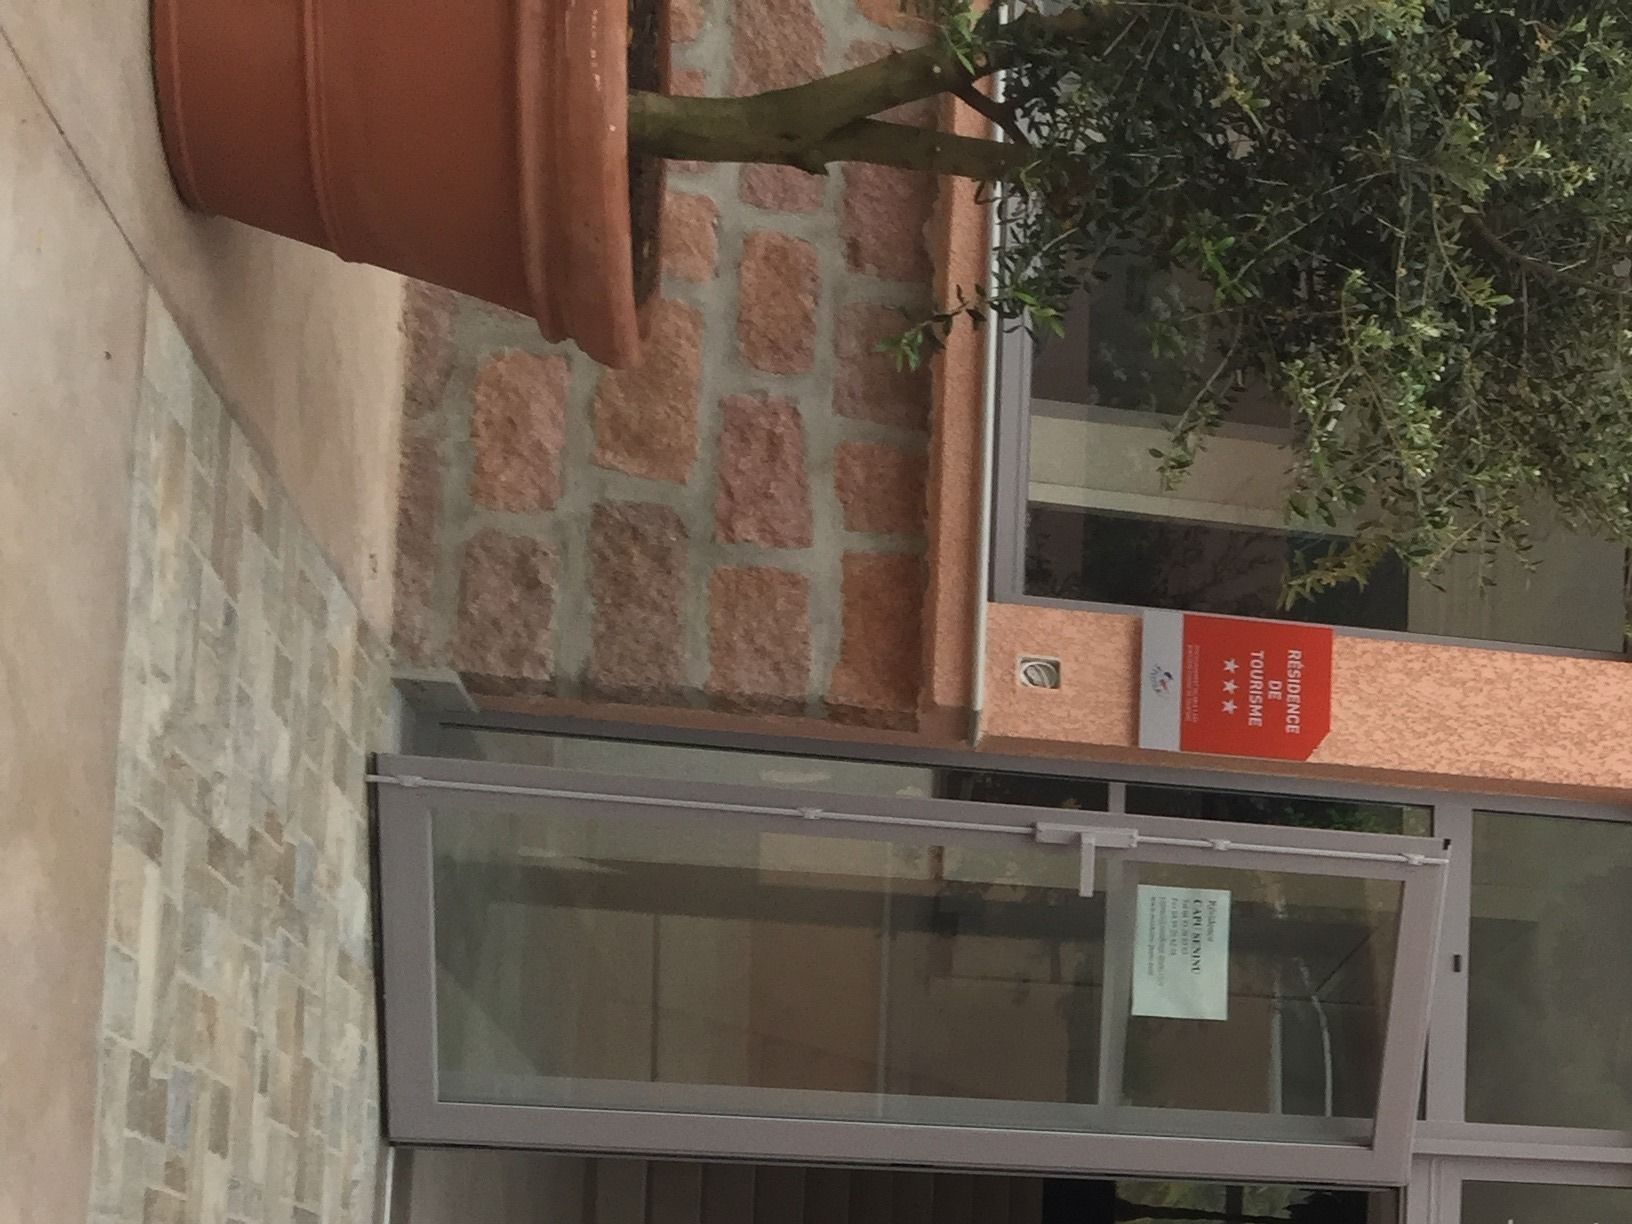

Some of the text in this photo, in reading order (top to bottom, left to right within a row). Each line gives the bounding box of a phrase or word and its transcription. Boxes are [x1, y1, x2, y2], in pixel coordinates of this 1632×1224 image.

[1248, 650, 1265, 728] TOURISME
[1267, 680, 1283, 700] DE
[1285, 649, 1304, 735] RÉSIDENCE
